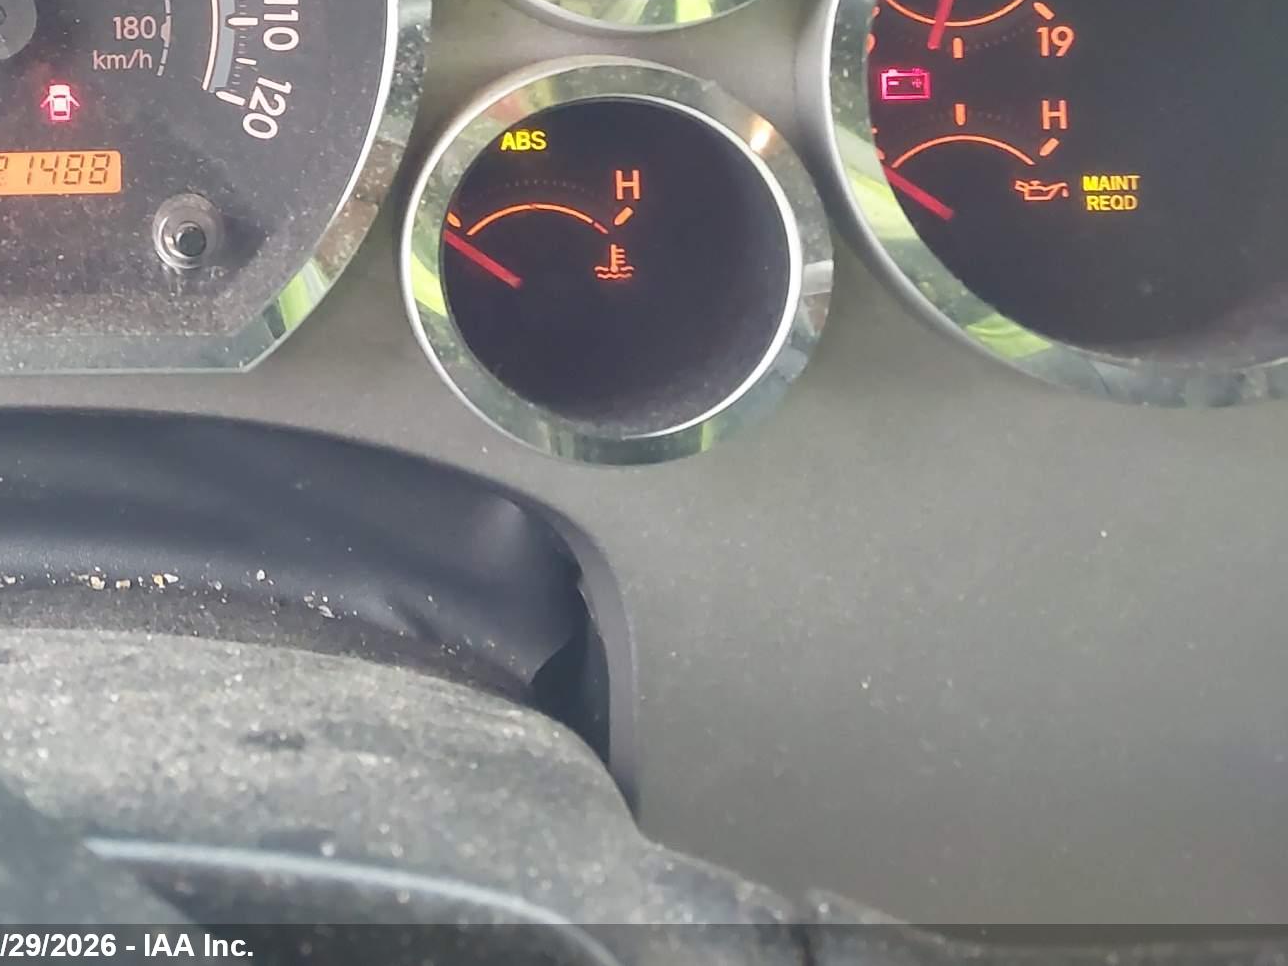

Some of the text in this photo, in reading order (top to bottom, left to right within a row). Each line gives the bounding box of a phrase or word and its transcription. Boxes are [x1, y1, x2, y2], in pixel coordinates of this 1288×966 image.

[112, 16, 157, 39] 180
[1036, 25, 1075, 57] 19
[92, 48, 153, 70] km/h
[242, 77, 293, 140] 120
[1041, 100, 1069, 130] H
[500, 130, 548, 151] ABS
[615, 169, 641, 200] H
[1082, 175, 1141, 191] MAINT
[1086, 195, 1139, 212] REQD
